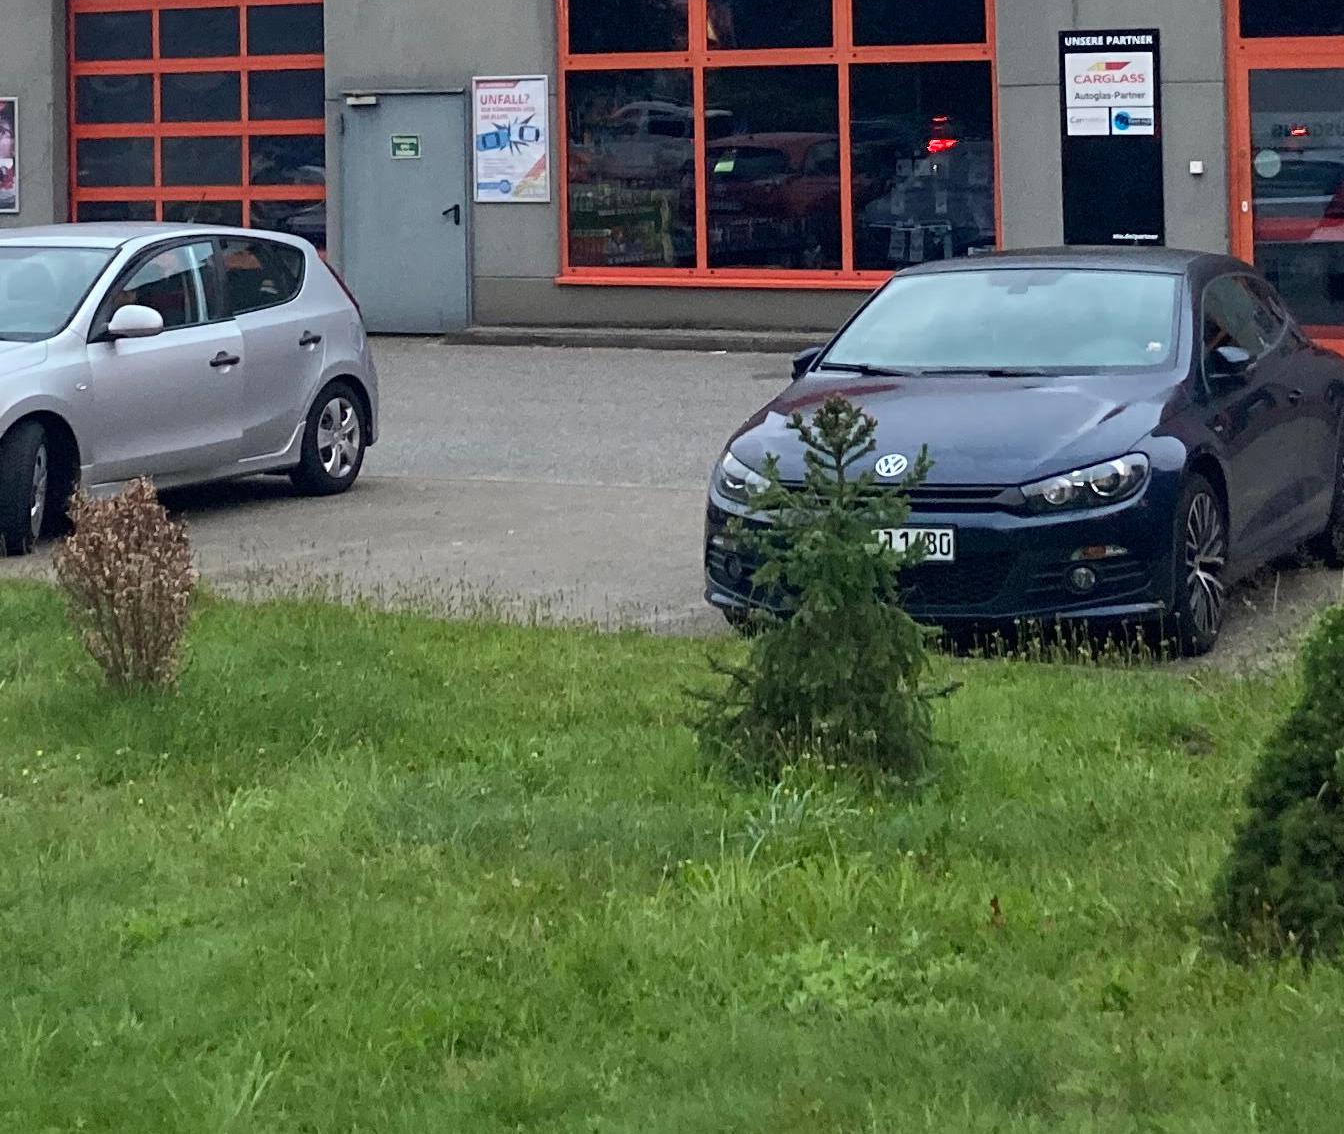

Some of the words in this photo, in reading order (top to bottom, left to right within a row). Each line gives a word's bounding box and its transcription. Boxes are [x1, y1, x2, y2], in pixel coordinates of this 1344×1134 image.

[1064, 35, 1104, 46] UNSERE
[1106, 34, 1153, 45] PARTNER
[1073, 73, 1146, 84] CARGLASS
[480, 93, 530, 105] UNFALL?
[1074, 90, 1147, 102] Autoglas-Partner
